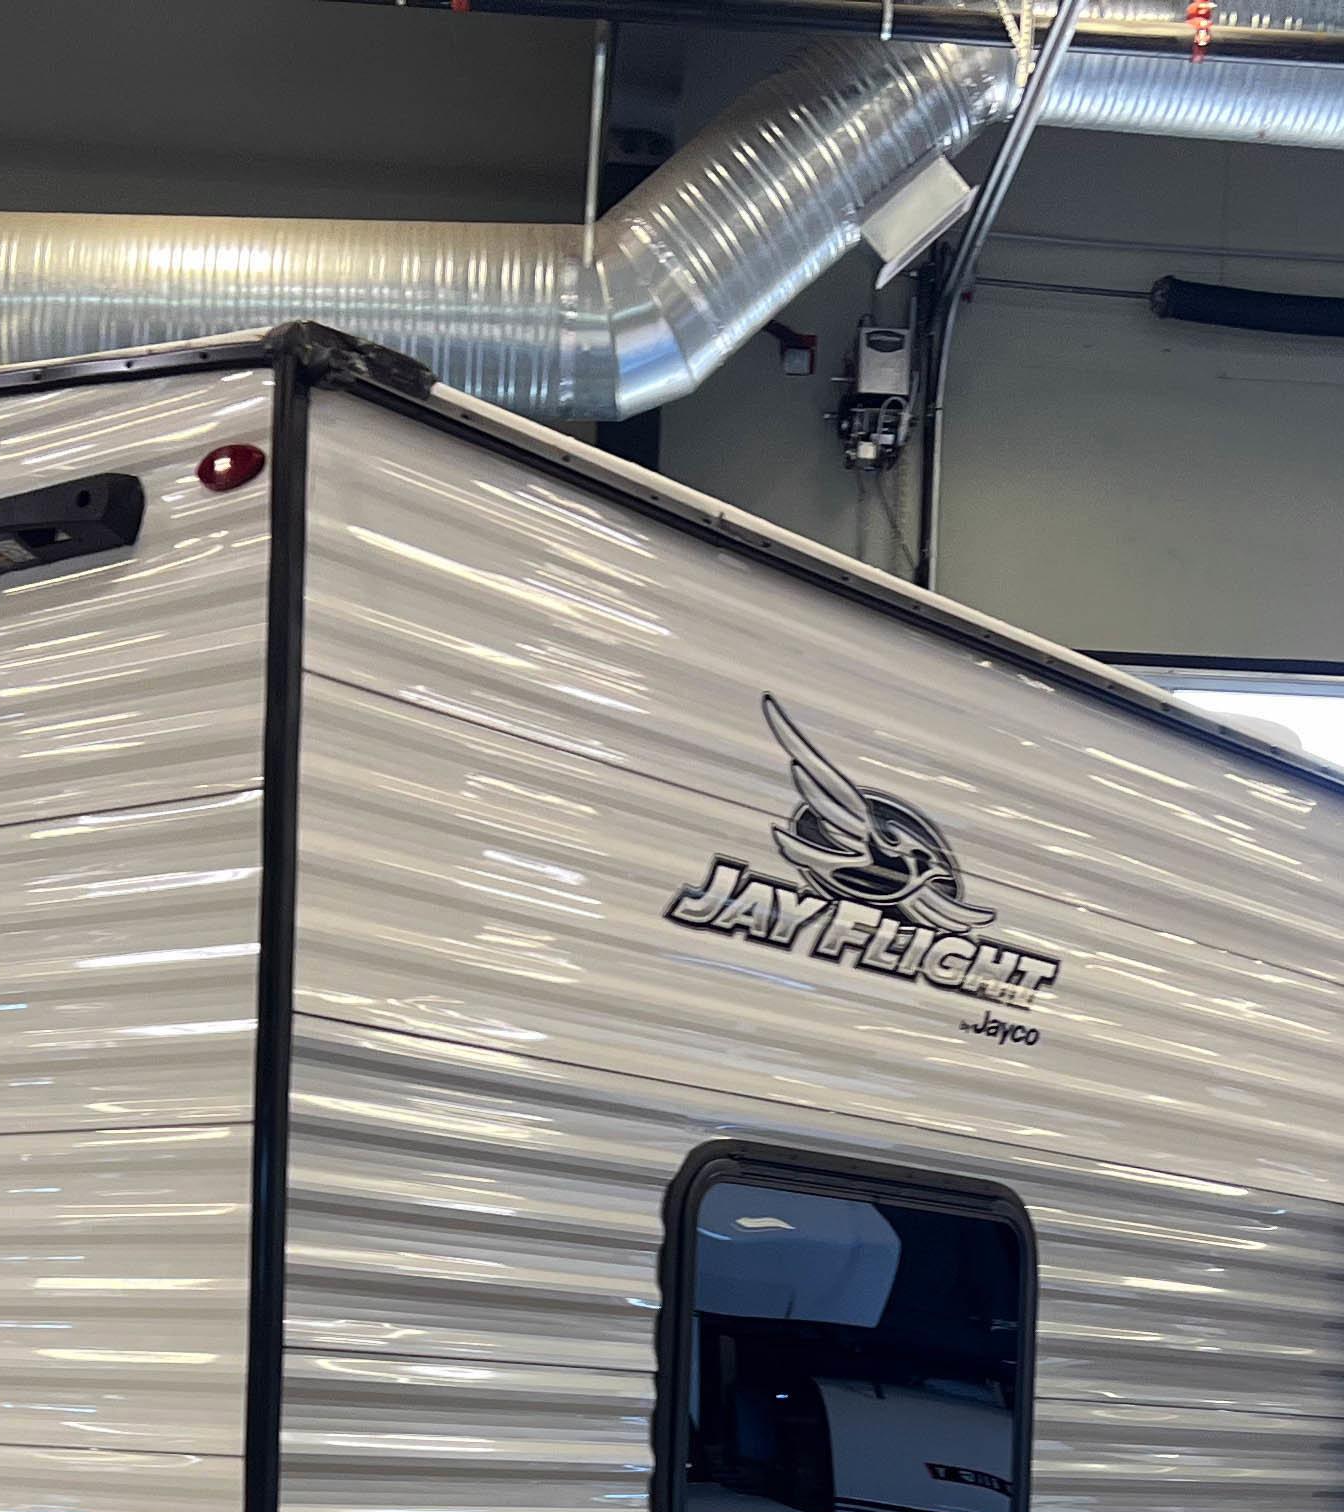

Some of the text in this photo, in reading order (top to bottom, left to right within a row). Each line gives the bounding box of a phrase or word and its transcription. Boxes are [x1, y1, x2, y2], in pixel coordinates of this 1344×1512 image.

[663, 852, 1059, 1010] JAY FLIGHT
[972, 1010, 1040, 1046] Jayco
